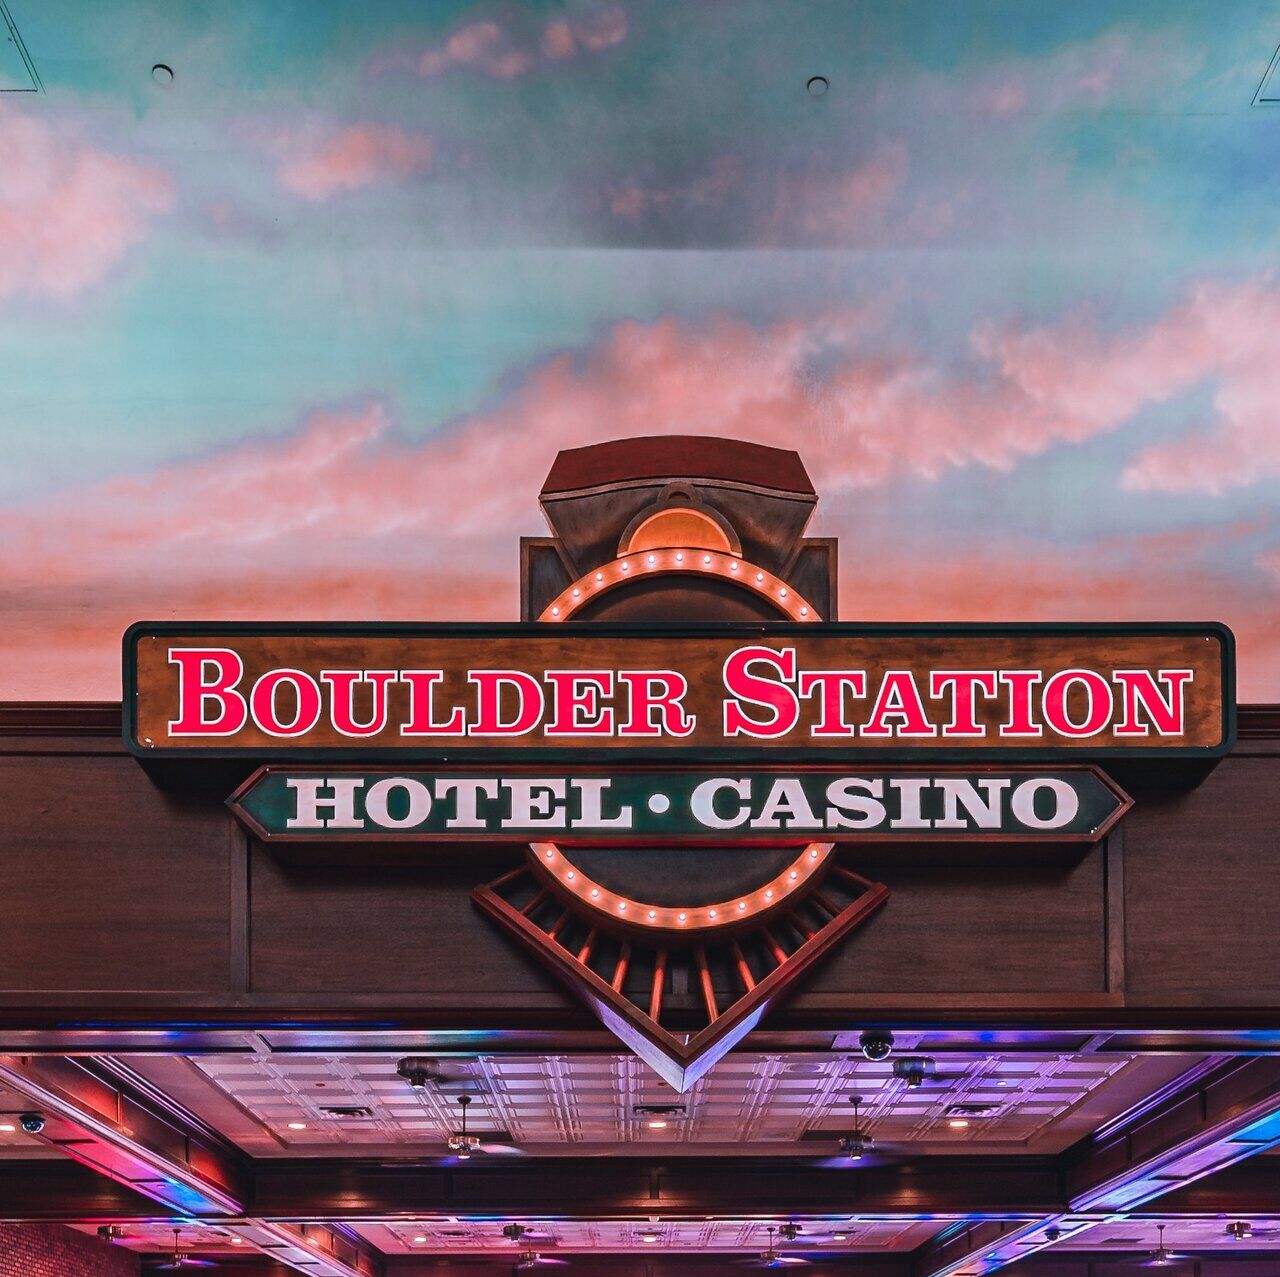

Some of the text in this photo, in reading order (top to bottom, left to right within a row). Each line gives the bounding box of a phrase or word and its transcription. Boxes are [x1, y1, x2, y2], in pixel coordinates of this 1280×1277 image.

[168, 645, 1195, 741] BOULDER STATION
[286, 775, 1080, 832] HOTEL CASINO
